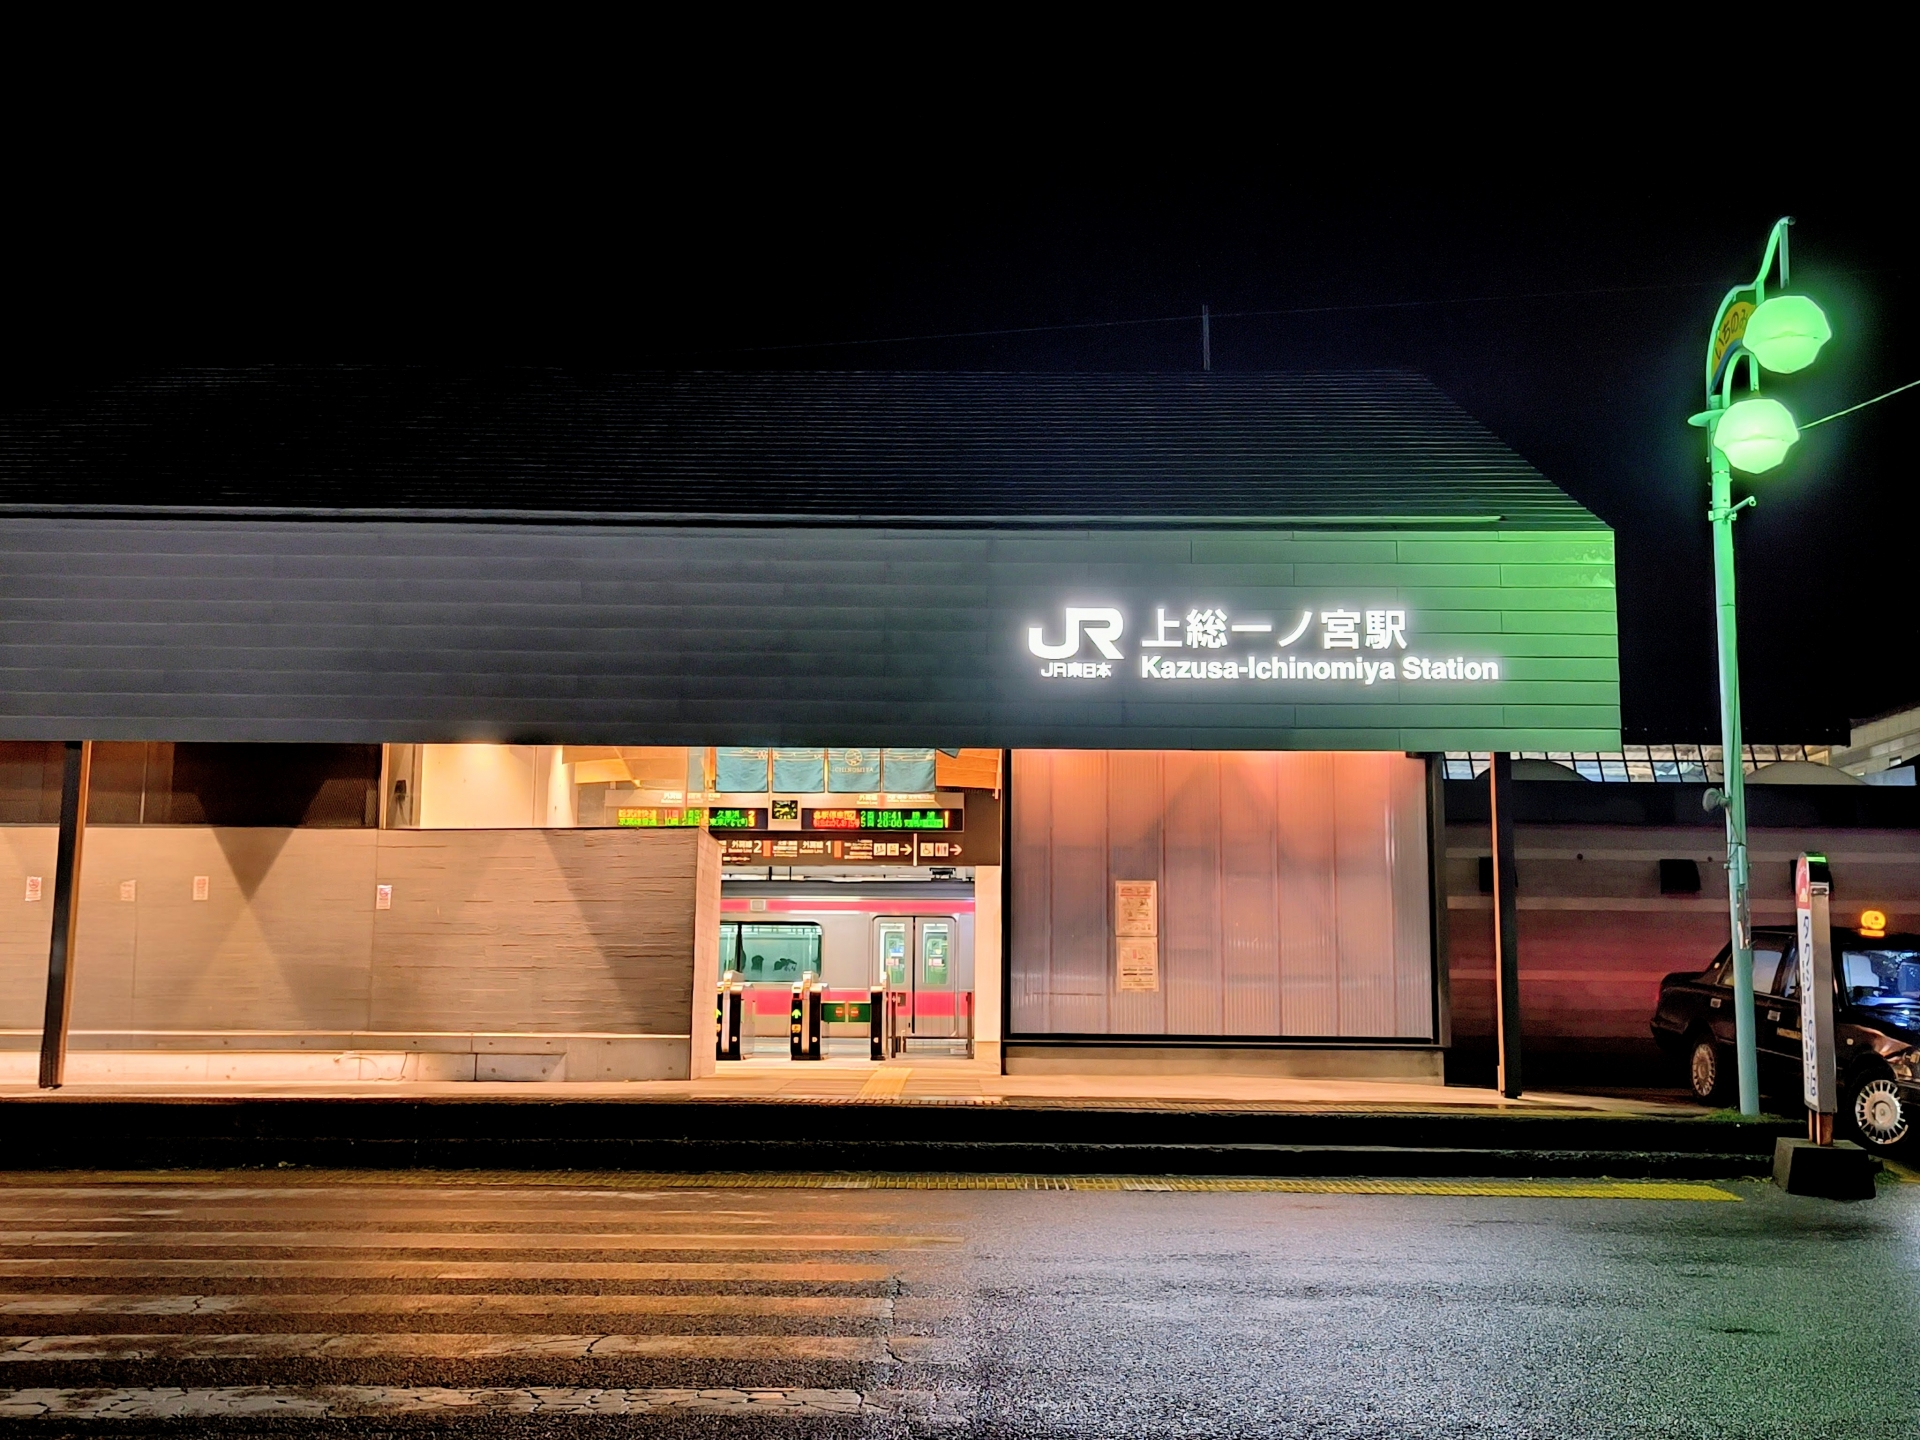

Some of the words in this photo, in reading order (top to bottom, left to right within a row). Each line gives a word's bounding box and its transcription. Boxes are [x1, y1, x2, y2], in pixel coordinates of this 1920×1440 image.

[1028, 607, 1125, 660] JR
[1141, 608, 1408, 650] 上総一ノ宮駅
[1040, 661, 1112, 679] JR東日本
[1141, 655, 1397, 686] Kazusa-Ichinomiya
[1402, 656, 1499, 681] Station
[753, 840, 762, 853] 2
[825, 840, 832, 854] 1
